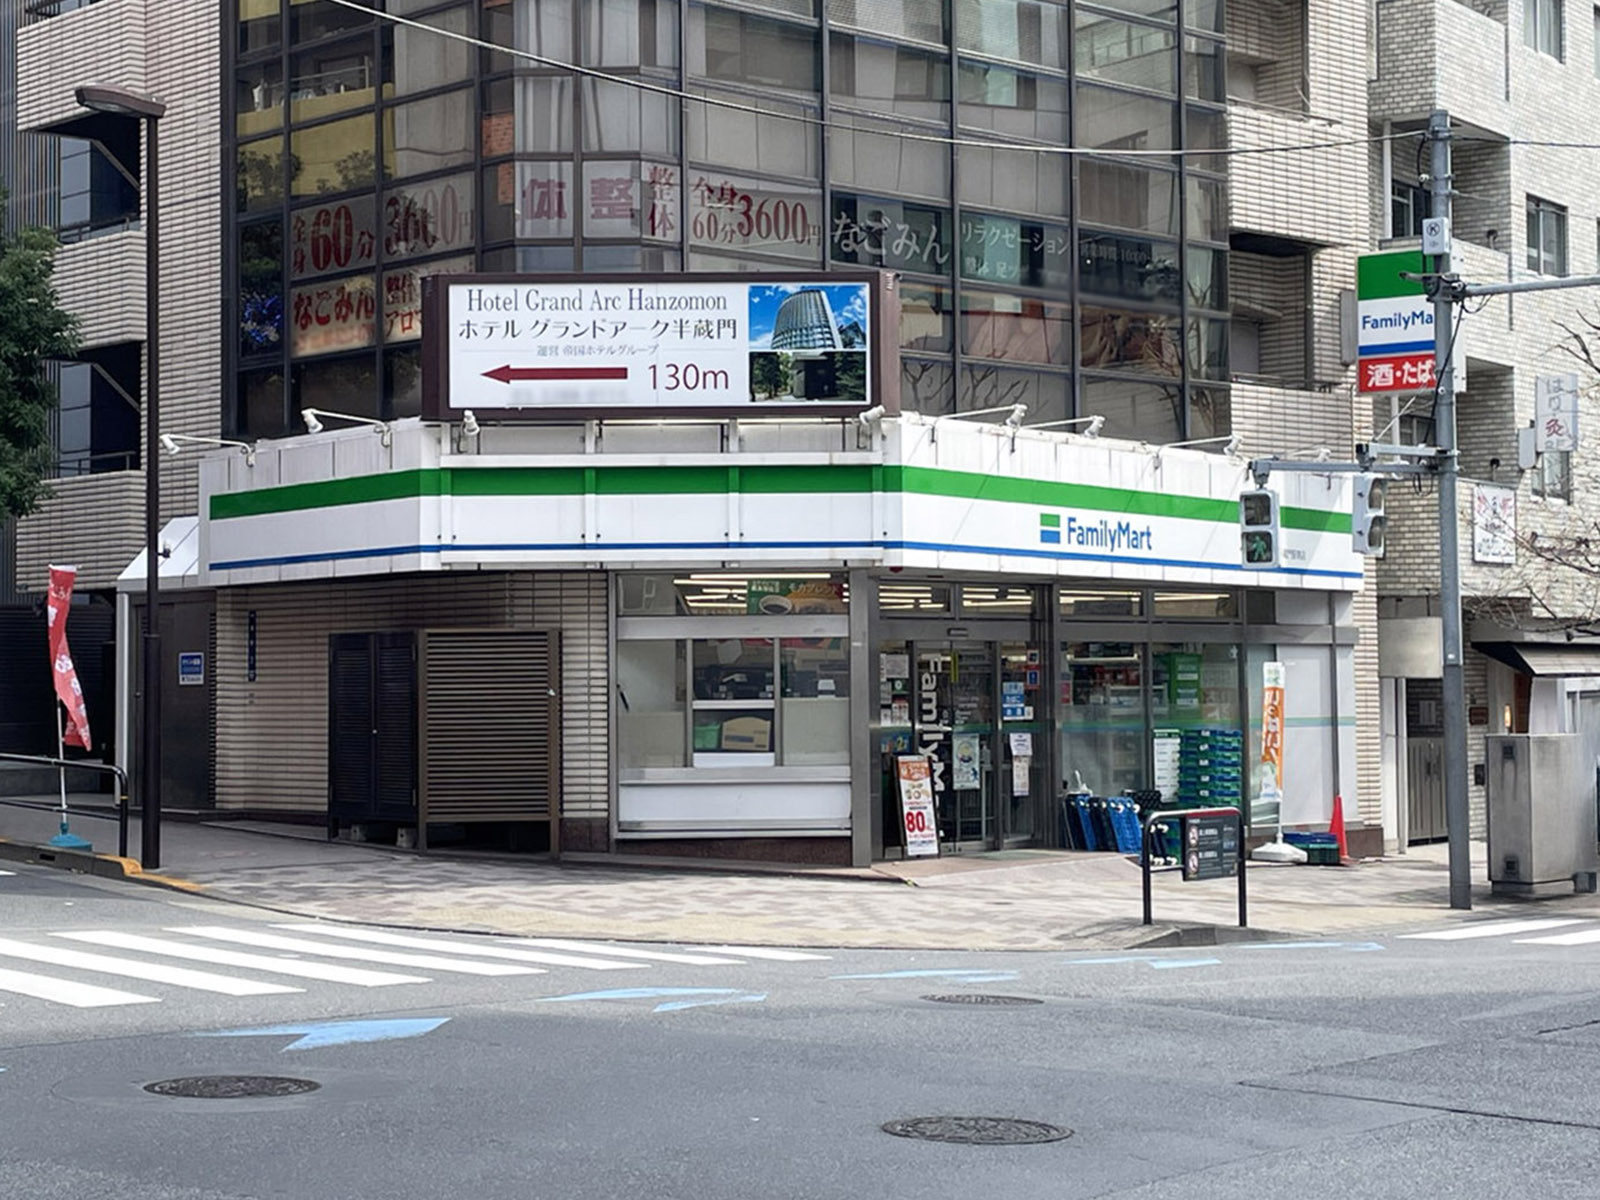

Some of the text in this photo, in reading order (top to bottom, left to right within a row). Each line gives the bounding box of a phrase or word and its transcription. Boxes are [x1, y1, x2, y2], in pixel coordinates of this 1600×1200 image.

[693, 176, 739, 212] 全身
[692, 211, 737, 244] 60分
[831, 210, 950, 265] なごみん
[961, 221, 1070, 256] リラクゼーション
[467, 287, 728, 312] Hotel Grand Arc Hanzomon
[459, 318, 737, 340] ホテル グランドアーク半蔵門
[648, 362, 729, 391] 130m
[1067, 516, 1152, 552] FamilyMart
